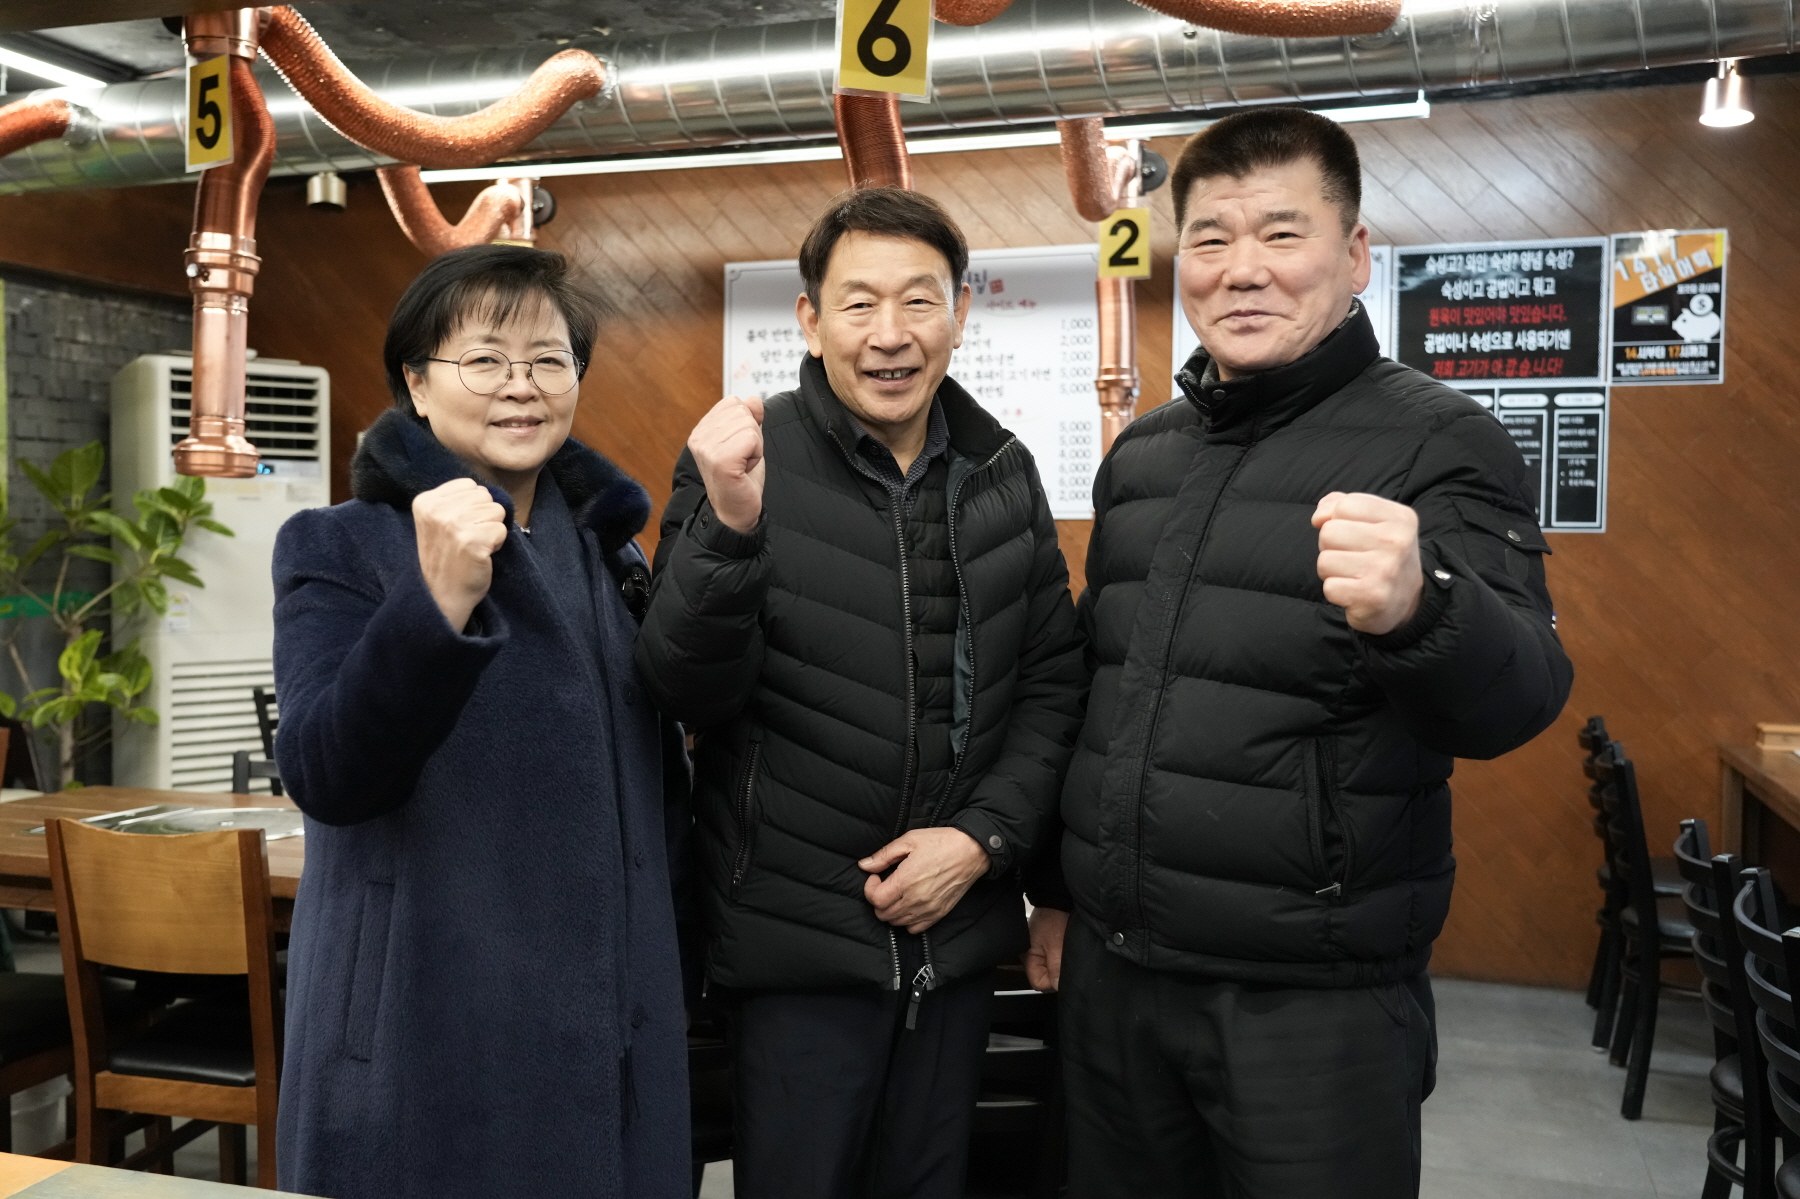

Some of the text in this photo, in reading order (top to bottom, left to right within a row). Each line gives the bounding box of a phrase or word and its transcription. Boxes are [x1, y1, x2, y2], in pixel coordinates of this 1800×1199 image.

[856, 0, 912, 77] 6
[196, 74, 222, 150] 5
[1108, 218, 1140, 267] 2
[1545, 248, 1575, 270] 숙성?
[1441, 278, 1485, 301] 숙성이고
[1061, 318, 1093, 331] 1,000
[1060, 334, 1092, 347] 2,000
[1424, 328, 1571, 354] 공법이나 숙성으로 사용되기엔
[1061, 350, 1092, 363] 7,000
[1060, 367, 1092, 380] 5,000
[1456, 358, 1489, 378] 고기가
[1060, 382, 1092, 395] 5,000
[1059, 421, 1091, 433] 5,000
[1059, 435, 1091, 446] 5,000
